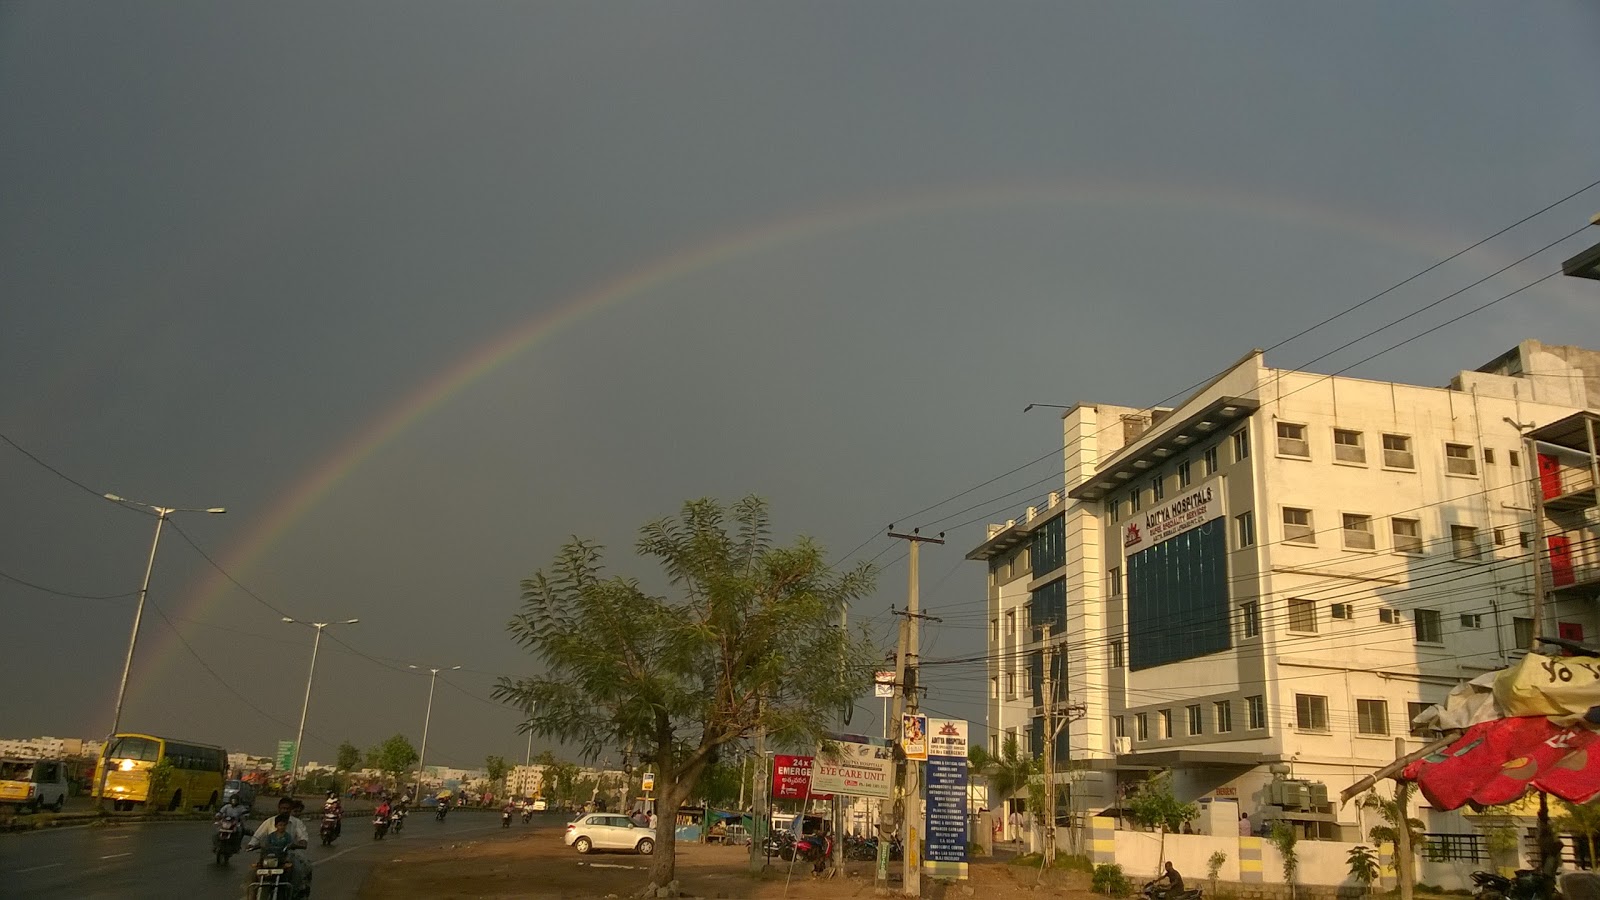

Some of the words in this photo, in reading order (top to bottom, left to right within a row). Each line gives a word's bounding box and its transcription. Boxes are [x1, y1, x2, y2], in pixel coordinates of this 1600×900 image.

[1145, 507, 1171, 530] ADITYA
[1171, 487, 1213, 517] HOSPITALS
[793, 758, 803, 766] 24
[820, 766, 837, 776] EYE
[838, 768, 862, 779] CARE
[864, 771, 886, 781] UNIT
[1216, 787, 1237, 796] EMERGENCY
